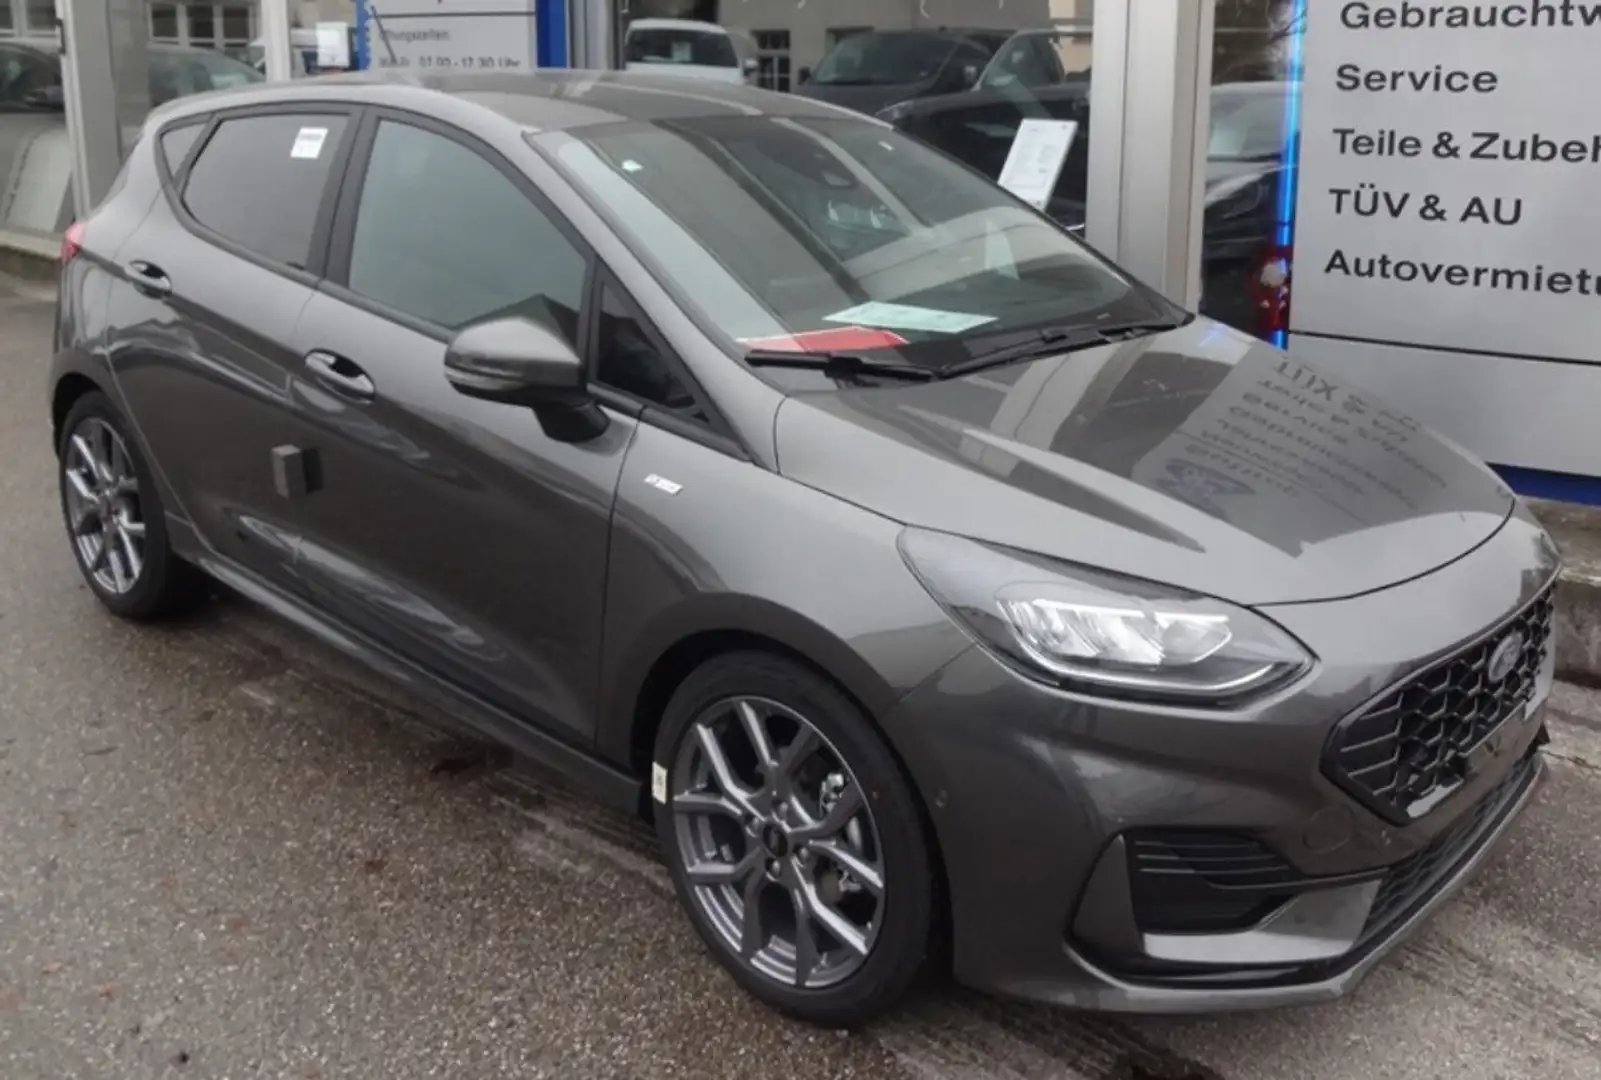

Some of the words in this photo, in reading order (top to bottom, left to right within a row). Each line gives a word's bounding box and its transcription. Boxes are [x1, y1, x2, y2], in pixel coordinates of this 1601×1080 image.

[1336, 64, 1498, 93] Service
[1332, 128, 1422, 157] Teile
[1432, 131, 1460, 159] &
[1328, 182, 1411, 219] TÜV
[1418, 194, 1447, 221] &
[1459, 197, 1522, 226] AU
[1323, 249, 1601, 296] Autovermiet
